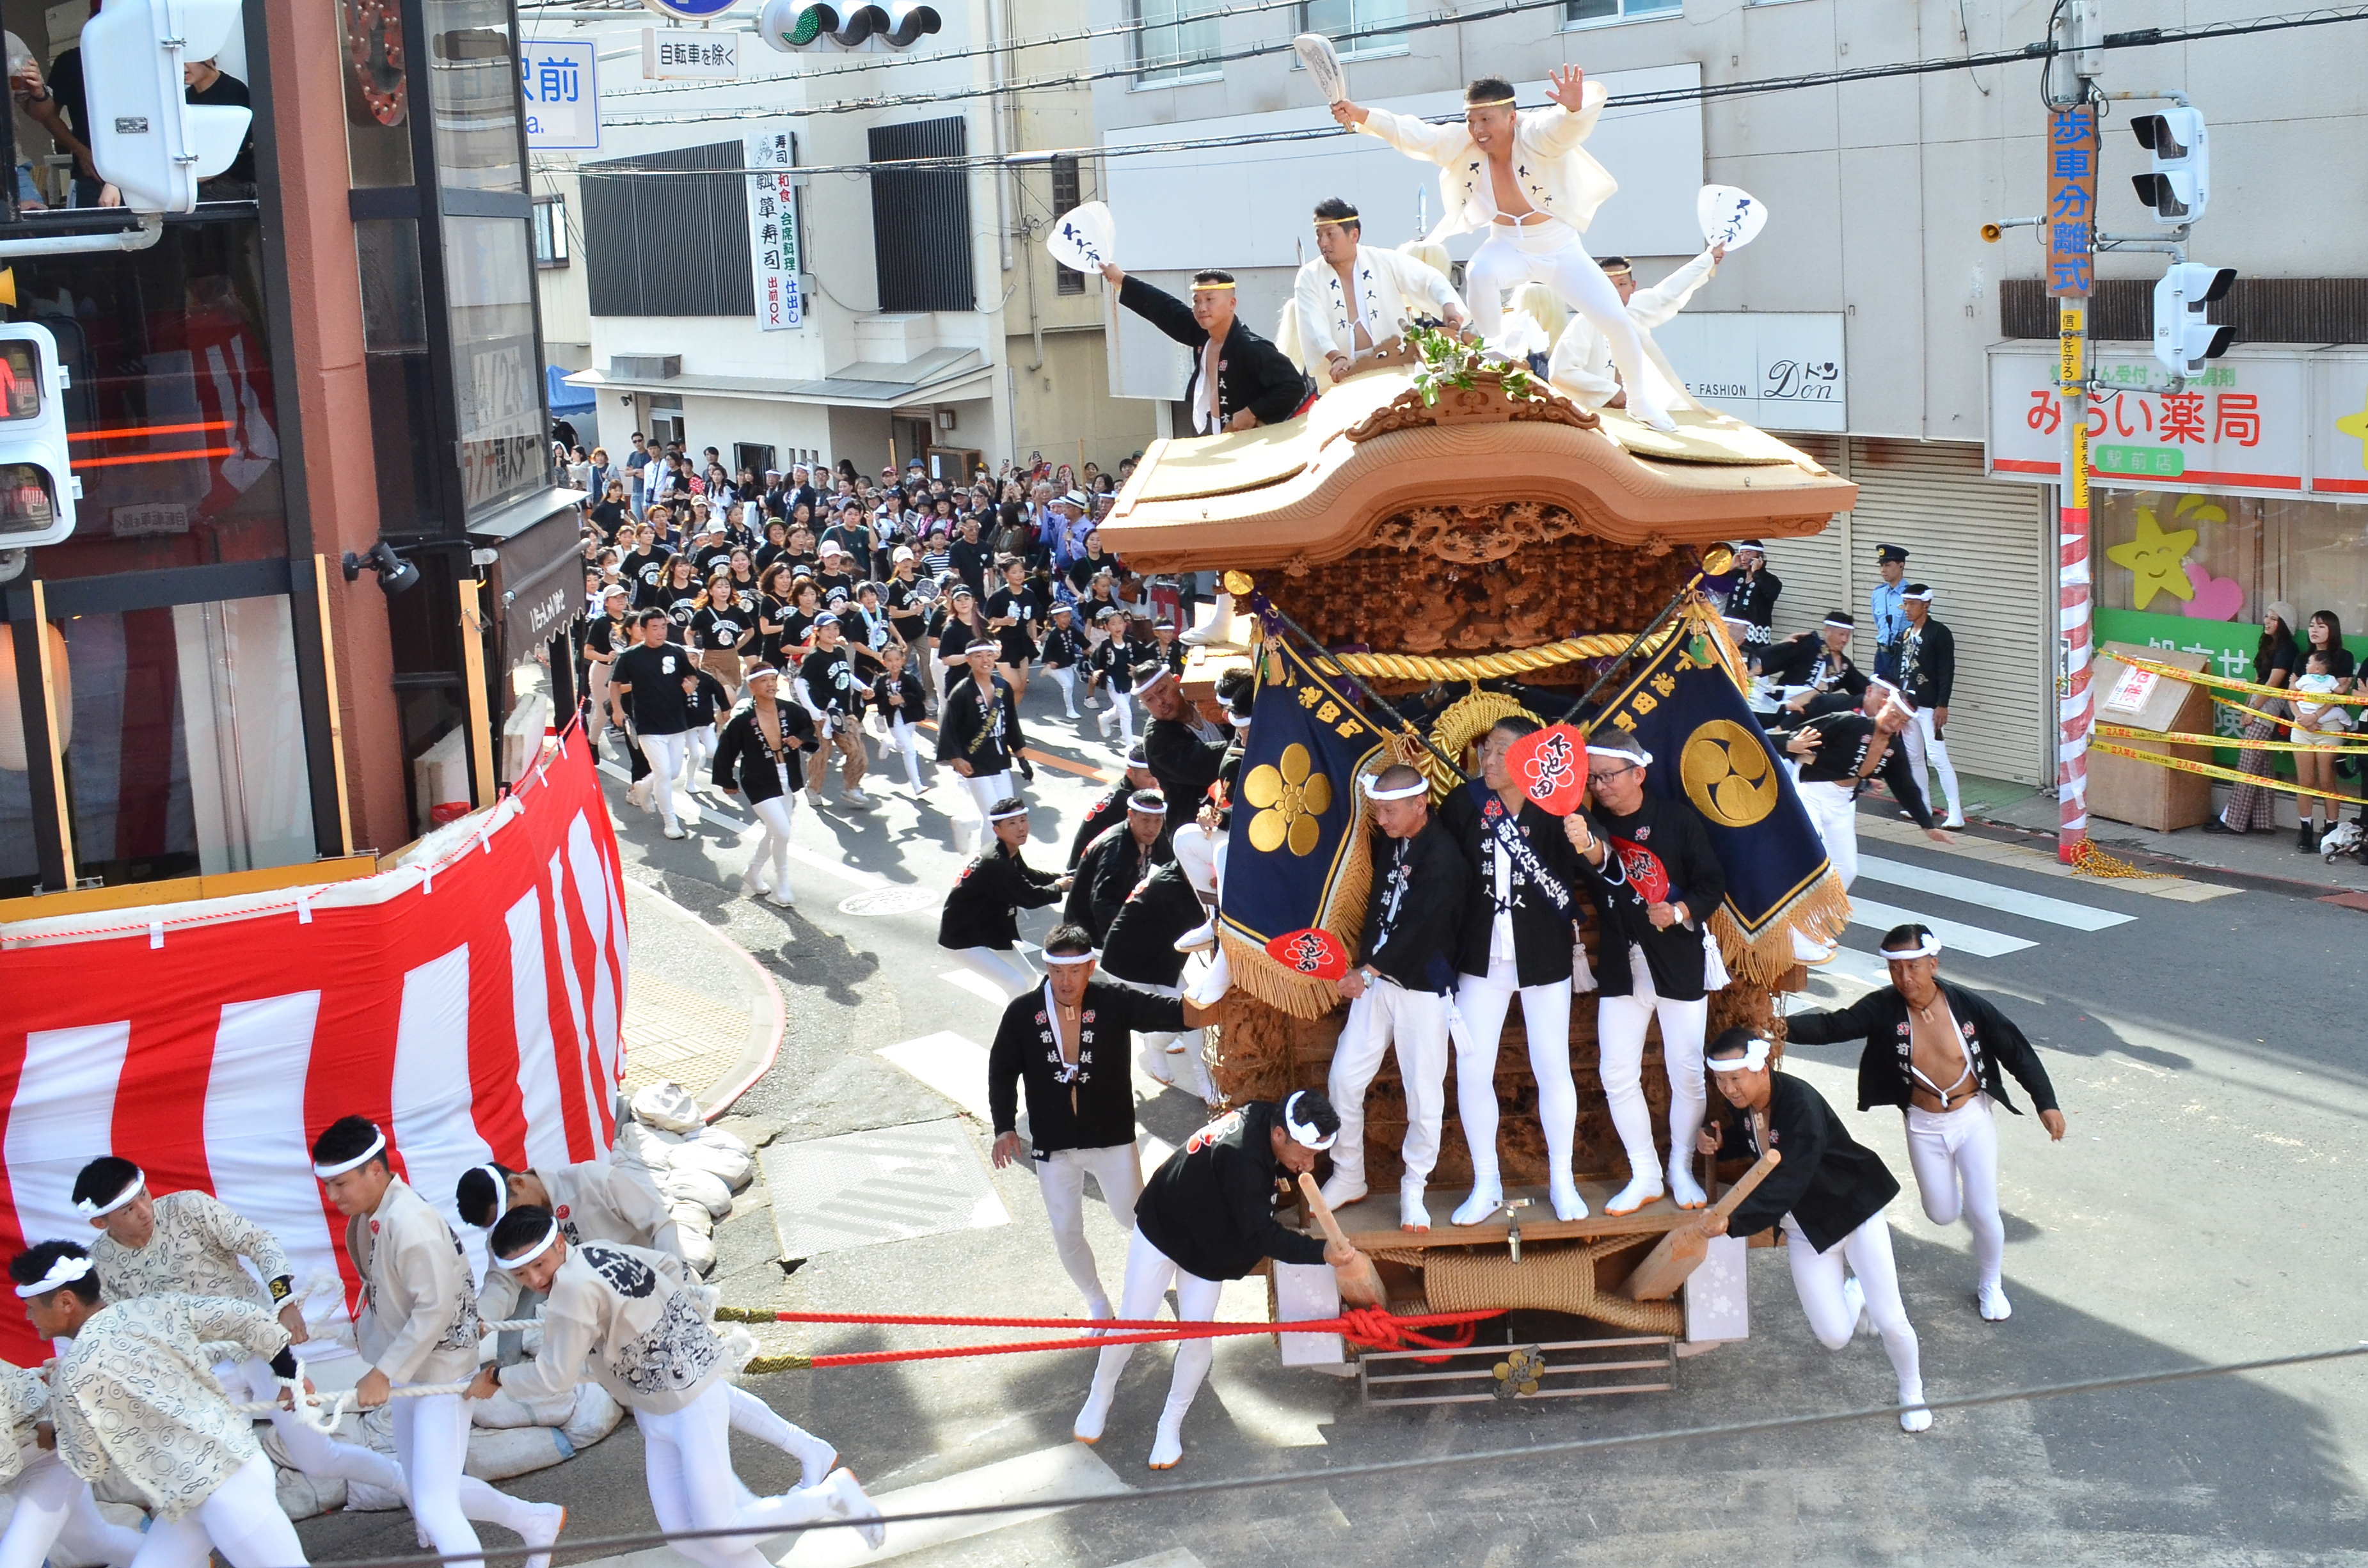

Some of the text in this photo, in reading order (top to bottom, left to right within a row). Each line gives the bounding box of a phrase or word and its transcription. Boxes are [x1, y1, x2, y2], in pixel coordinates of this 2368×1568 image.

[661, 42, 735, 66] 自転車を除く
[2054, 111, 2091, 290] 歩車分離式
[1699, 384, 1747, 396] FASHION
[1764, 360, 1832, 399] Don
[1219, 377, 1230, 423] 大工方
[2028, 390, 2261, 447] みらい薬局
[2107, 450, 2172, 470] 駅前店
[662, 656, 675, 674] S
[781, 719, 790, 754] 三十組
[2106, 727, 2132, 738] 立入禁止
[2170, 733, 2197, 743] 立入禁止
[1530, 733, 1571, 798] 下池田
[2111, 745, 2137, 759] 立入禁止
[2176, 759, 2203, 773] 立入禁止
[1481, 838, 1495, 898] 世話人
[1296, 933, 1324, 972] 下池田
